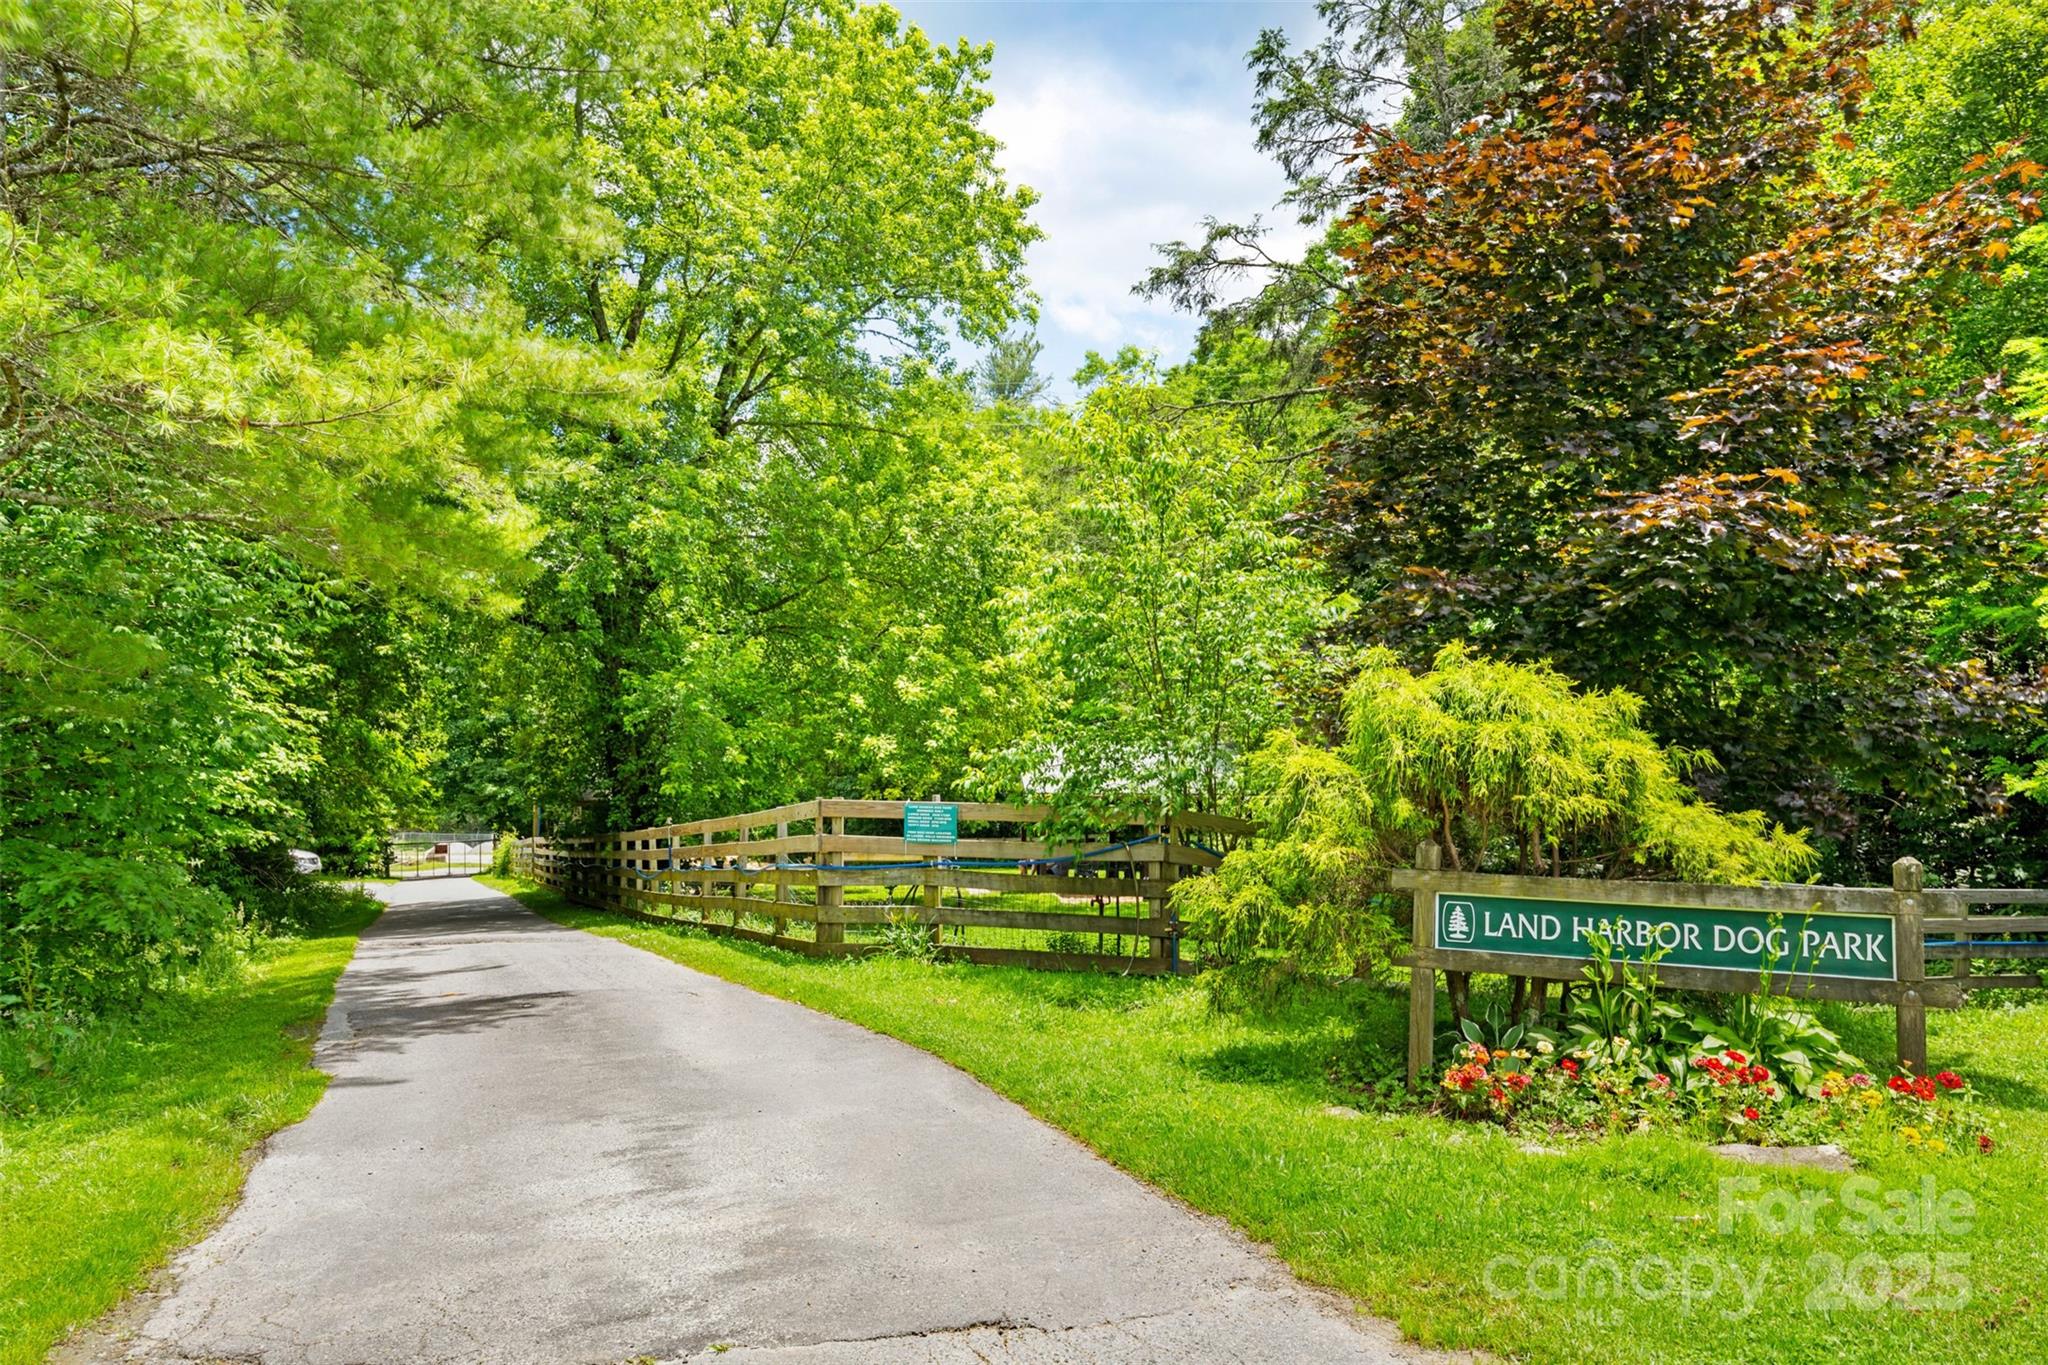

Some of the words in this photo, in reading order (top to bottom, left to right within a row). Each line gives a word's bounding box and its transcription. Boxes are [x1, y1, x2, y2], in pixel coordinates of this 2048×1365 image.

[1483, 911, 1562, 941] LAND
[1572, 916, 1703, 951] HARBOR
[1713, 925, 1790, 957] DOG
[1801, 930, 1888, 963] PARK
